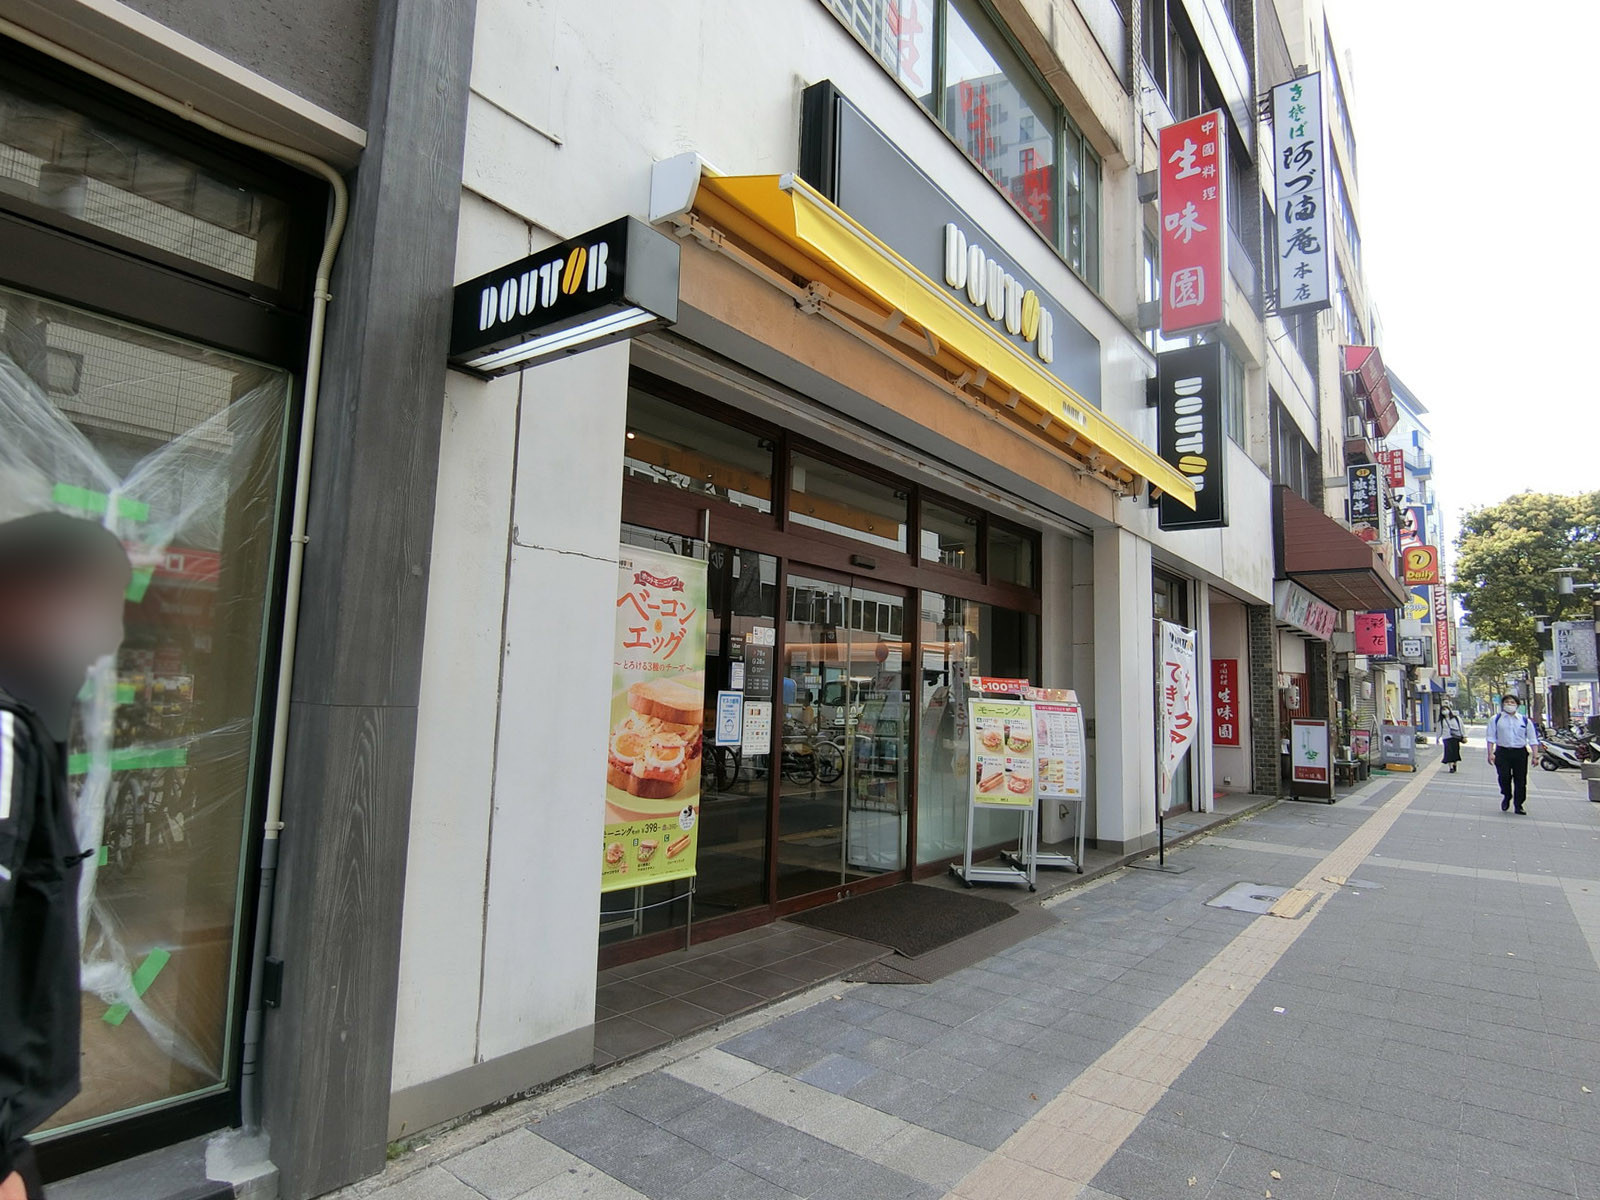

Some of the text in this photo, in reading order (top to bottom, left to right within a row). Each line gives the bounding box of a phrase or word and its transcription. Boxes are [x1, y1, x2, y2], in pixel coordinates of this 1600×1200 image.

[1164, 138, 1207, 310] 生味園
[479, 241, 609, 331] DOUTOR
[945, 223, 1053, 364] DOUTOR
[1407, 570, 1434, 581] Daily
[617, 589, 697, 625] ベーコン
[623, 626, 687, 660] エッグ
[978, 706, 1020, 717] モーニング
[1217, 688, 1234, 740] 生味園
